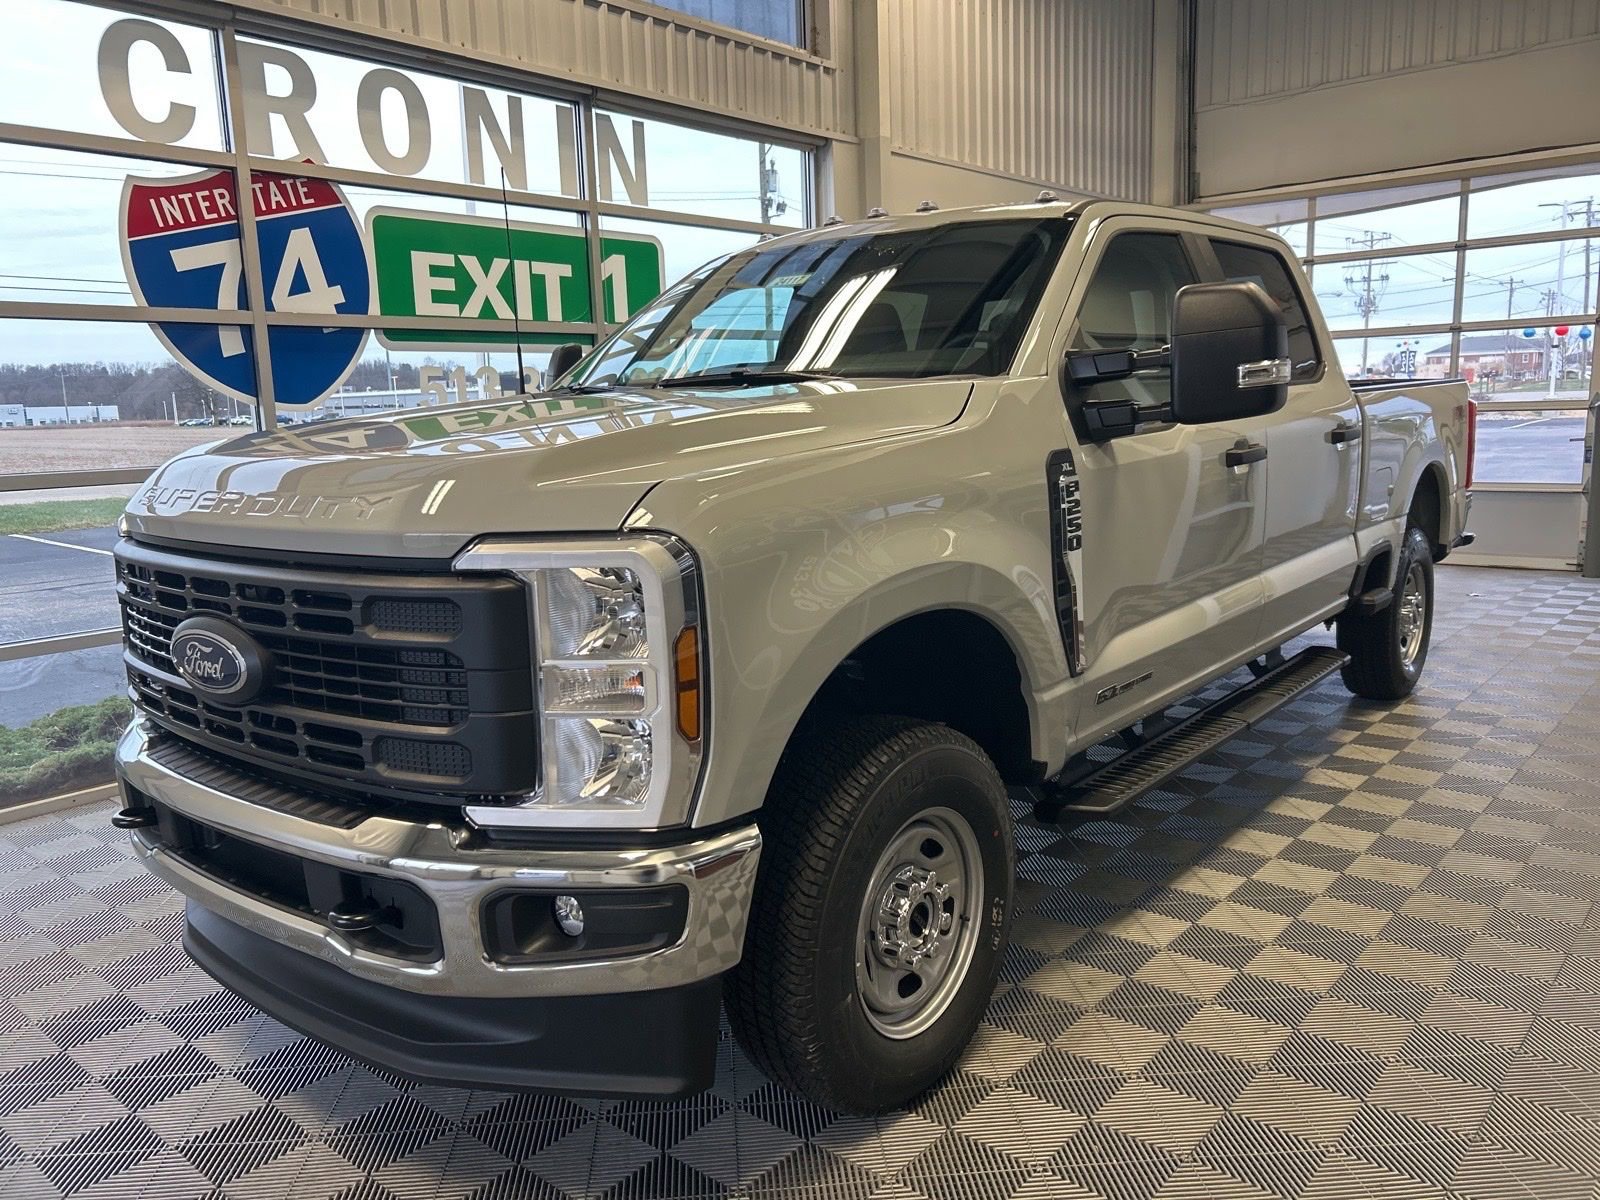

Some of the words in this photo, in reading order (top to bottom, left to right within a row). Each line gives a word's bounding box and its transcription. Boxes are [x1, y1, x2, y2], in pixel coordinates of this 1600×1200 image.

[98, 19, 648, 206] CRONIN
[150, 178, 315, 227] INTERTATE
[170, 227, 345, 357] 74
[411, 251, 573, 323] EXIT
[601, 254, 628, 323] 1
[1062, 463, 1073, 472] XL
[138, 486, 248, 515] SUPER
[246, 495, 393, 519] DUTY
[184, 641, 225, 681] Ford
